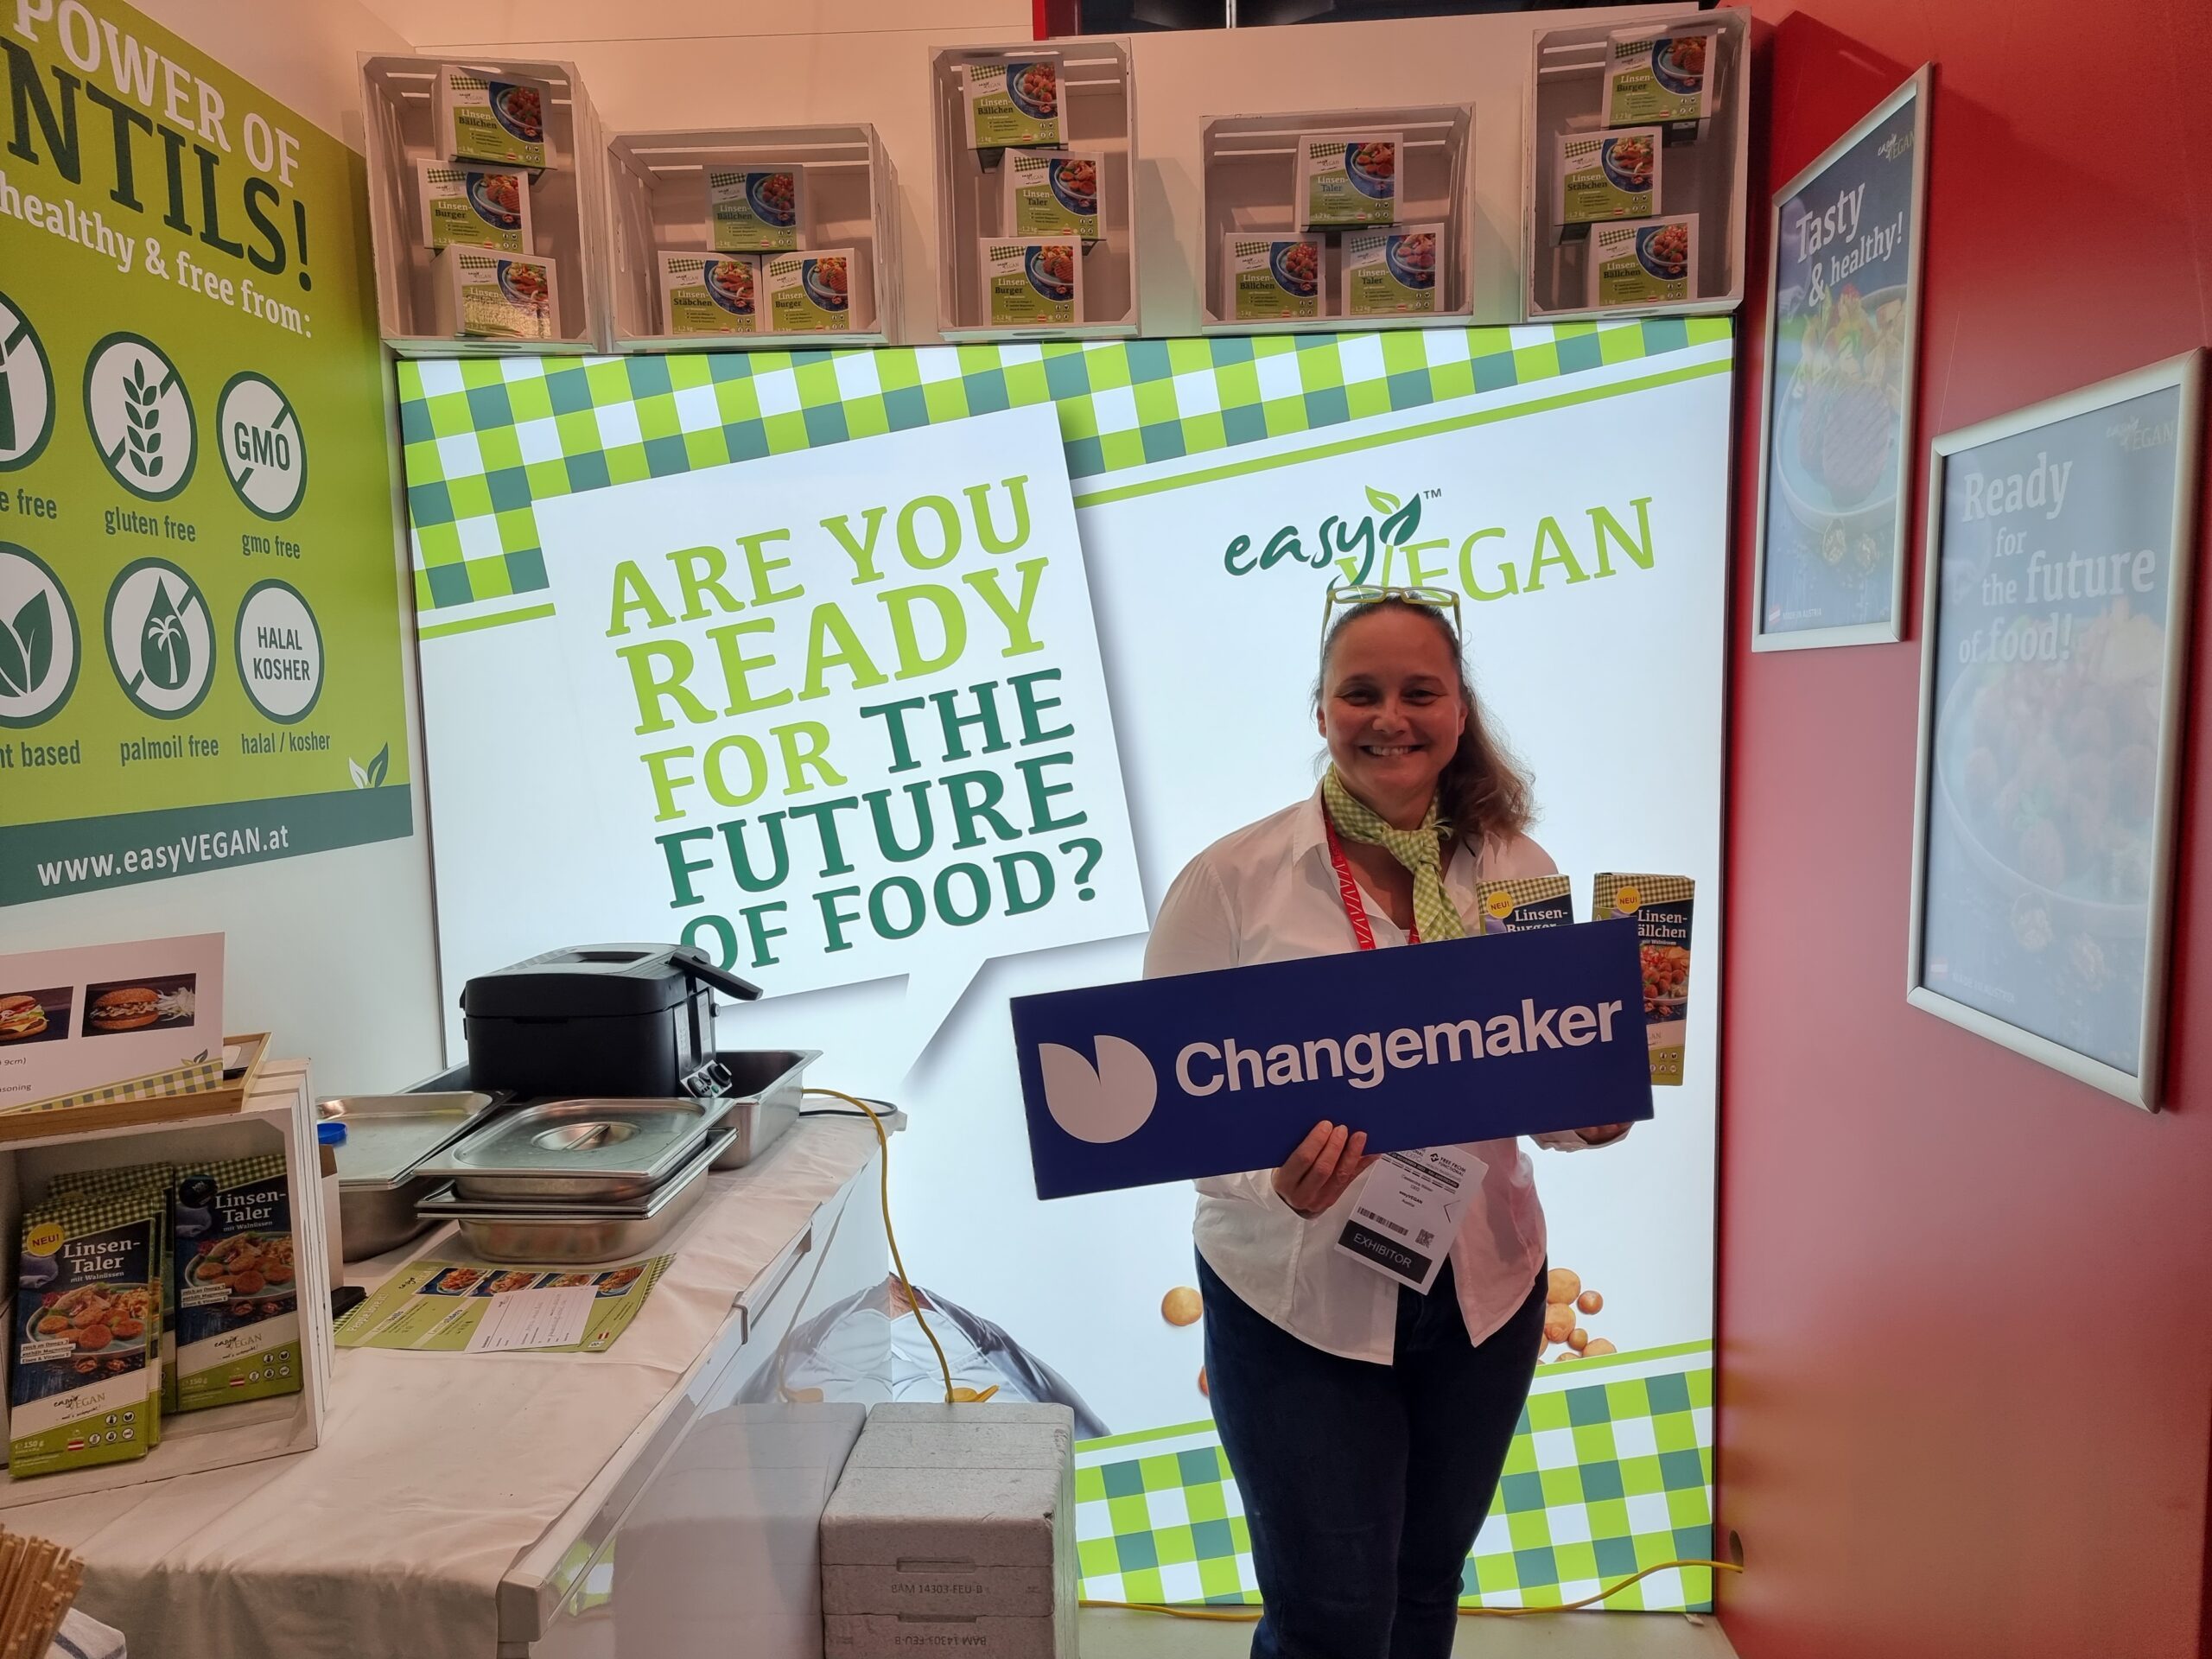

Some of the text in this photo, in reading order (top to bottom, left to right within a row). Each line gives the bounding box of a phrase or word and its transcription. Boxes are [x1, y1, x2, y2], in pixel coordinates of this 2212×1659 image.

[1617, 84, 1647, 92] Burger
[1621, 75, 1654, 84] Linsen-
[14, 0, 301, 188] POWER OF
[461, 109, 494, 120] Linsen-
[977, 106, 1014, 115] Bällchen
[458, 117, 498, 129] Bällchen
[0, 36, 312, 292] NTILS!
[1567, 181, 1608, 191] Stäbchen
[1573, 174, 1605, 182] Linsen-
[1023, 189, 1053, 199] Linsen-
[1320, 184, 1343, 193] Taler
[435, 209, 467, 219] Burger
[438, 201, 472, 210] Linsen-
[1796, 182, 1866, 264] Tasty
[0, 171, 312, 339] healthy & free from:
[1808, 211, 1903, 307] & healthy!
[1357, 269, 1389, 277] Linsen-
[1604, 270, 1641, 279] Bällchen
[1607, 262, 1638, 270] Linsen-
[995, 287, 1023, 296] Burger
[1240, 282, 1275, 290] Bällchen
[674, 298, 713, 307] Stäbchen
[775, 300, 802, 308] Burger
[234, 422, 290, 472] GMO
[1423, 488, 1443, 501] TM
[1962, 452, 2073, 523] Ready
[17, 488, 58, 519] free
[105, 507, 197, 543] gluten free
[242, 533, 301, 560] gmo free
[1994, 527, 2027, 557] for
[605, 474, 1031, 638] ARE YOU
[1224, 496, 1656, 607] easy VEGAN
[1982, 549, 2156, 606] the future
[257, 626, 302, 651] HALAL
[615, 556, 1050, 736] READY
[1959, 612, 2072, 664] of food!
[253, 657, 311, 682] KOSHER
[120, 734, 219, 766] palmoil free
[241, 731, 331, 754] halal / kosher
[639, 667, 1075, 823] FOR THE
[21, 740, 81, 767] based
[654, 751, 1088, 909] FUTURE
[37, 825, 289, 887] www.easyVEGAN.at
[679, 836, 1103, 975] OF FOOD?
[1491, 901, 1510, 911] NEU!
[1619, 896, 1637, 905] NEU!
[1515, 909, 1568, 922] Linsen-
[1637, 909, 1688, 924] Linsen-
[1637, 924, 1687, 938] ällchen
[1175, 998, 1623, 1097] Changemaker
[0, 1084, 32, 1093] soning
[1440, 1157, 1452, 1166] FREE
[1451, 1160, 1466, 1173] FROM
[215, 1191, 286, 1210] Linsen-
[222, 1207, 272, 1224] Taler
[32, 1233, 60, 1247] NEU!
[63, 1239, 141, 1258] Linsen-
[1353, 1233, 1413, 1268] EXHIBITOR
[71, 1256, 124, 1274] Taler
[85, 1271, 124, 1281] Walnüssen
[891, 1583, 916, 1594] BAM
